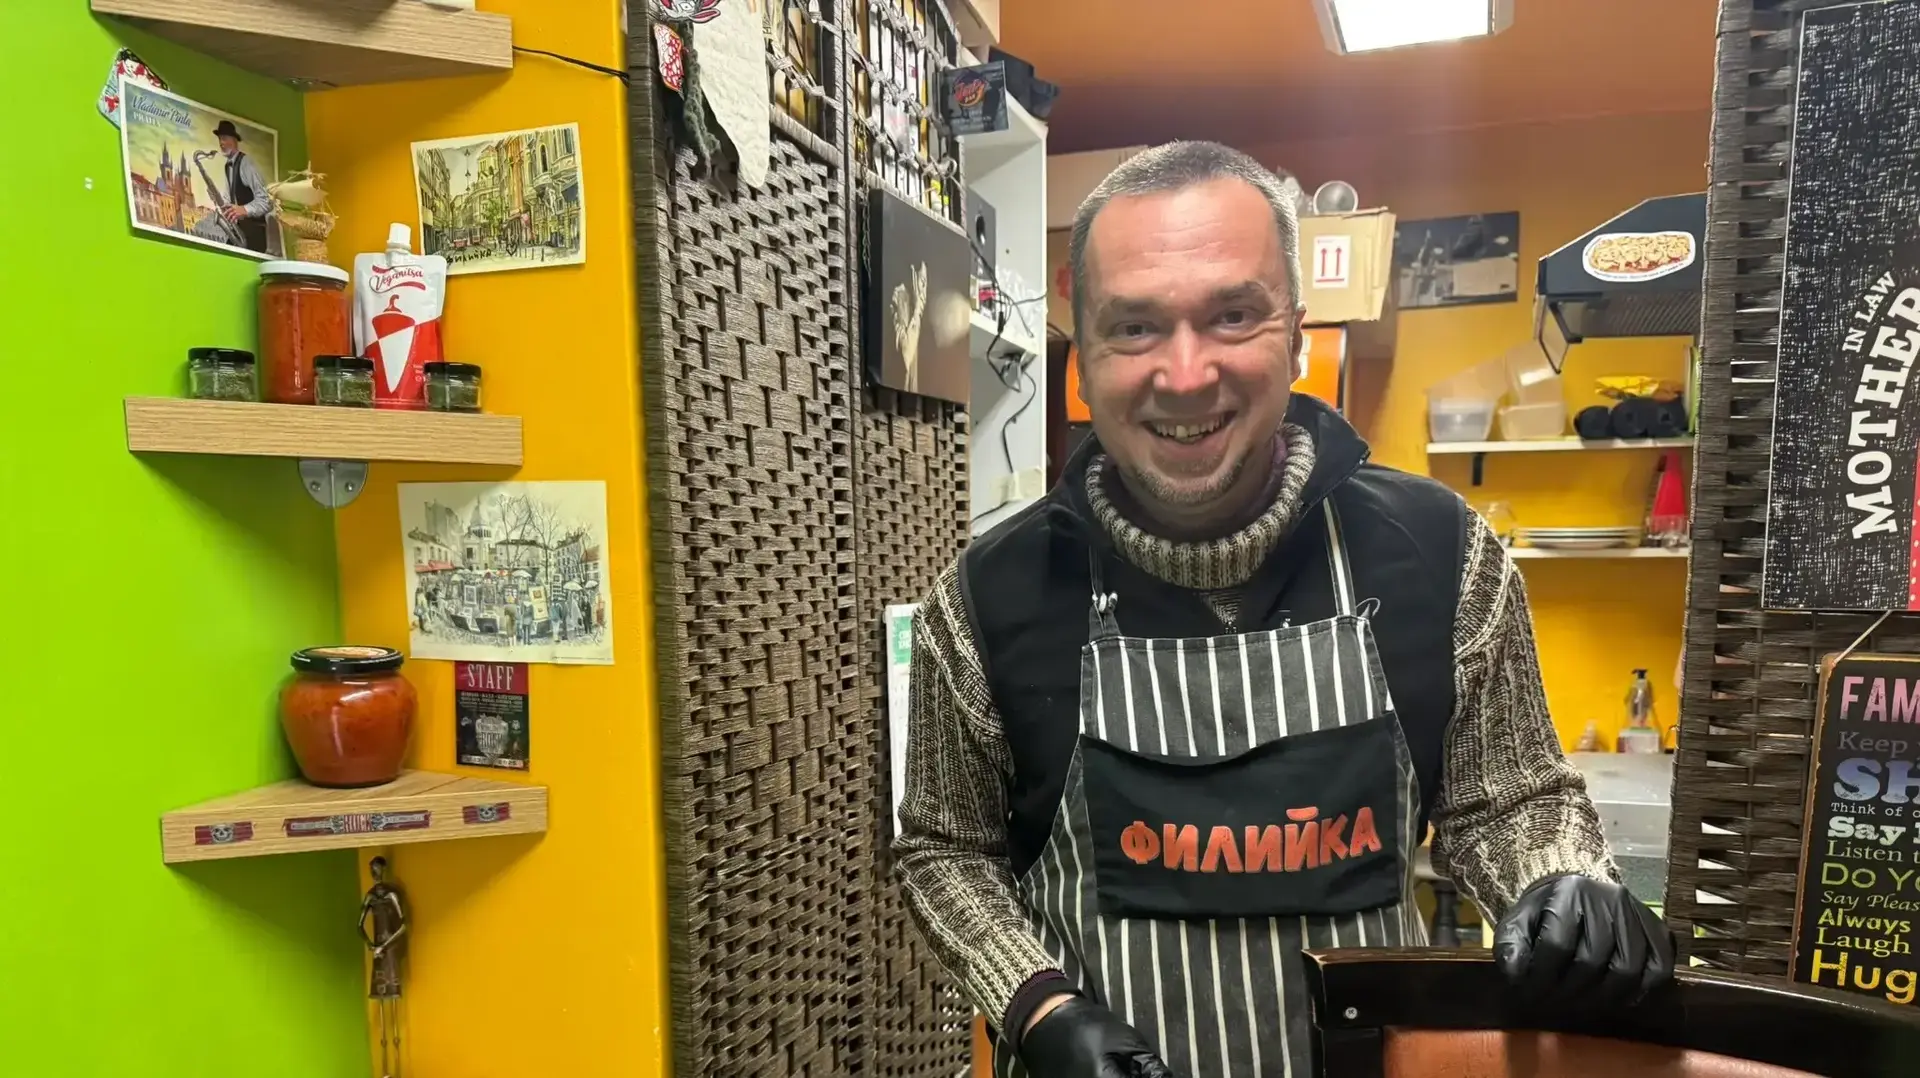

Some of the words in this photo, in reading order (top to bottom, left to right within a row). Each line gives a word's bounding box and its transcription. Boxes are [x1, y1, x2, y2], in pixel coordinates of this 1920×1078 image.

[1842, 327, 1867, 353] IN
[1855, 271, 1895, 323] LAW
[1846, 287, 1920, 539] MOTHER
[467, 663, 514, 691] STAFF
[1840, 675, 1920, 724] FAM
[1836, 730, 1908, 759] Keep
[1830, 801, 1876, 815] Think
[1884, 806, 1904, 817] of
[1120, 806, 1382, 873] ФИЛИЙКА
[1827, 815, 1907, 846] Say
[1825, 839, 1904, 863] Listen
[1820, 890, 1860, 911] Say
[1817, 907, 1912, 936] Always
[1815, 926, 1912, 958] Laugh
[1810, 948, 1918, 1004] Hug
